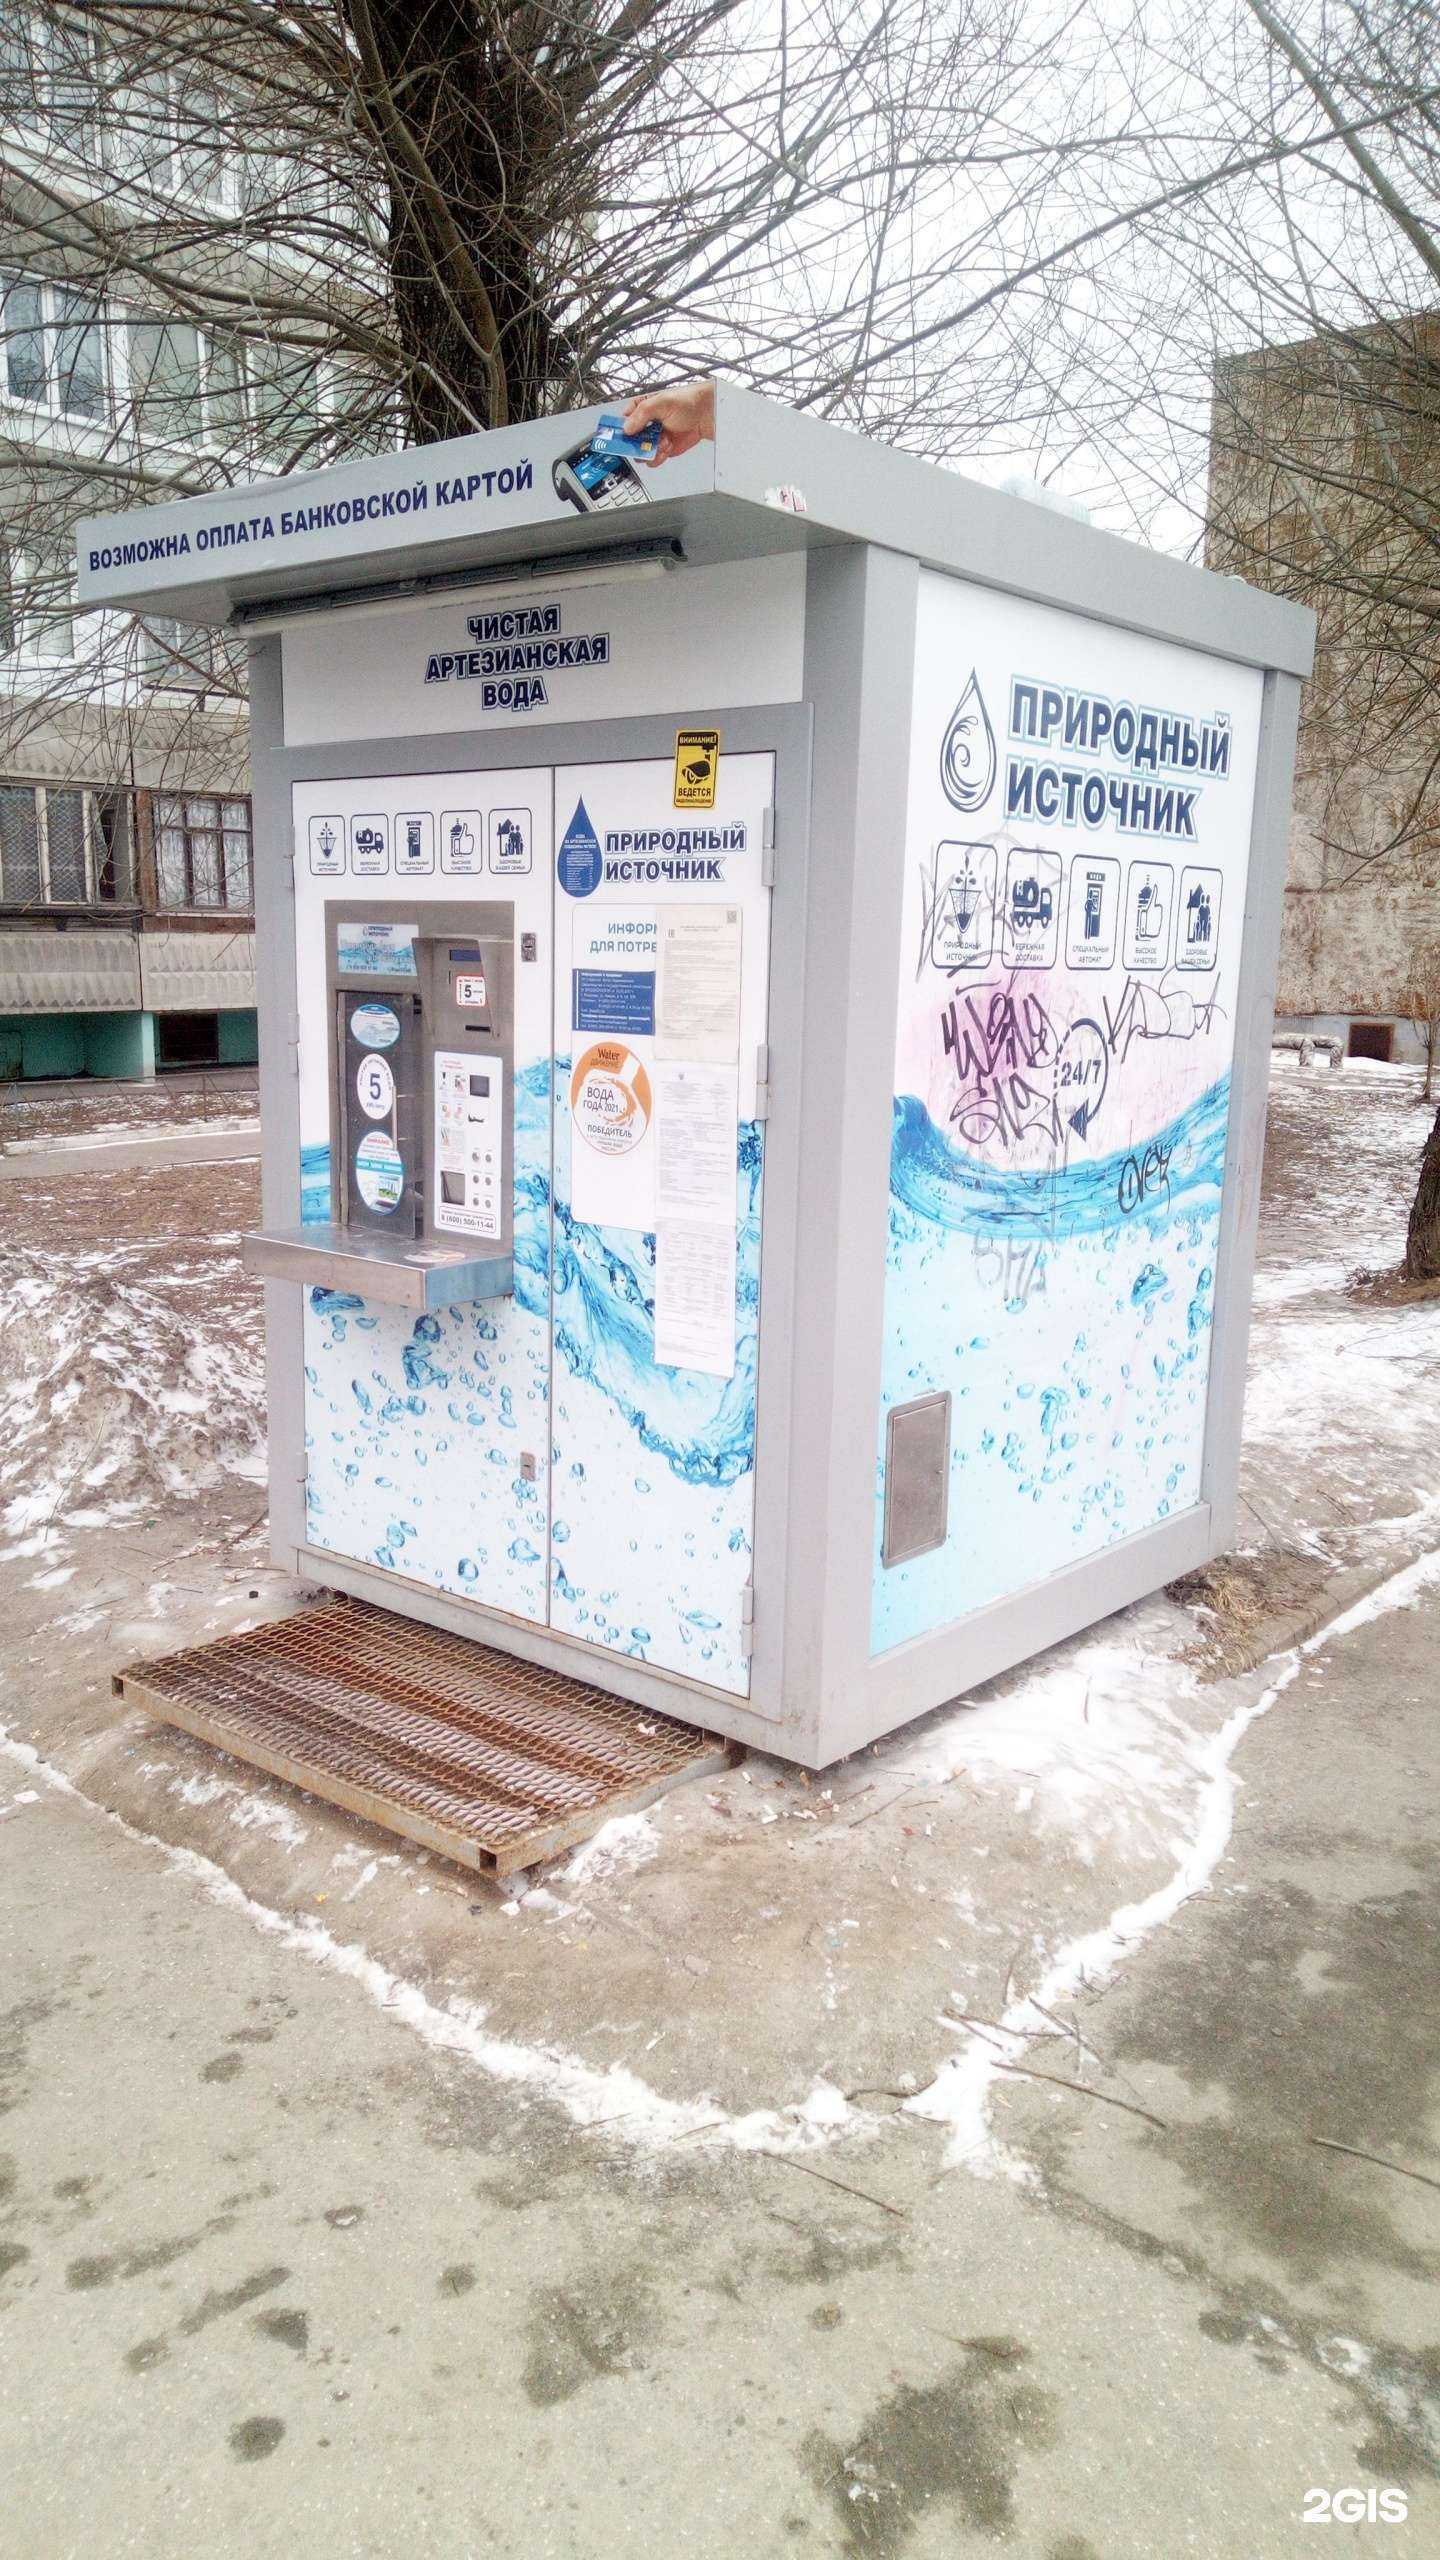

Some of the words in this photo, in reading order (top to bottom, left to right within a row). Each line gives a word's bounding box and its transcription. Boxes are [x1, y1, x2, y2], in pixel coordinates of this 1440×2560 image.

[90, 533, 191, 571] ВОЗМОЖНА
[196, 516, 275, 551] ОПЛАТА
[281, 480, 428, 536] БАНКОВСКОЙ
[436, 457, 533, 506] КАРТОЙ
[467, 604, 561, 643] ЧИСТАЯ
[425, 632, 610, 683] АРТЕЗИАНСКАЯ
[482, 676, 548, 711] ВОДА
[1010, 678, 1231, 777] ПРИРОДНЫЙ
[678, 787, 711, 798] ВЕДЕТСЯ
[1005, 758, 1200, 839] ИСТОЧНИК
[605, 823, 746, 856] ПРИРОДНЫЙ
[605, 858, 723, 882] ИСТОЧНИК
[590, 940, 614, 953] ДЛЯ
[464, 985, 472, 998] 5
[598, 1047, 620, 1061] Water
[370, 1073, 381, 1100] 5
[1061, 1060, 1102, 1087] 24/7
[583, 1100, 602, 1112] ГОДА
[587, 1086, 614, 1103] ВОДА
[587, 1124, 632, 1138] ПОБЕДИТЕЛЬ
